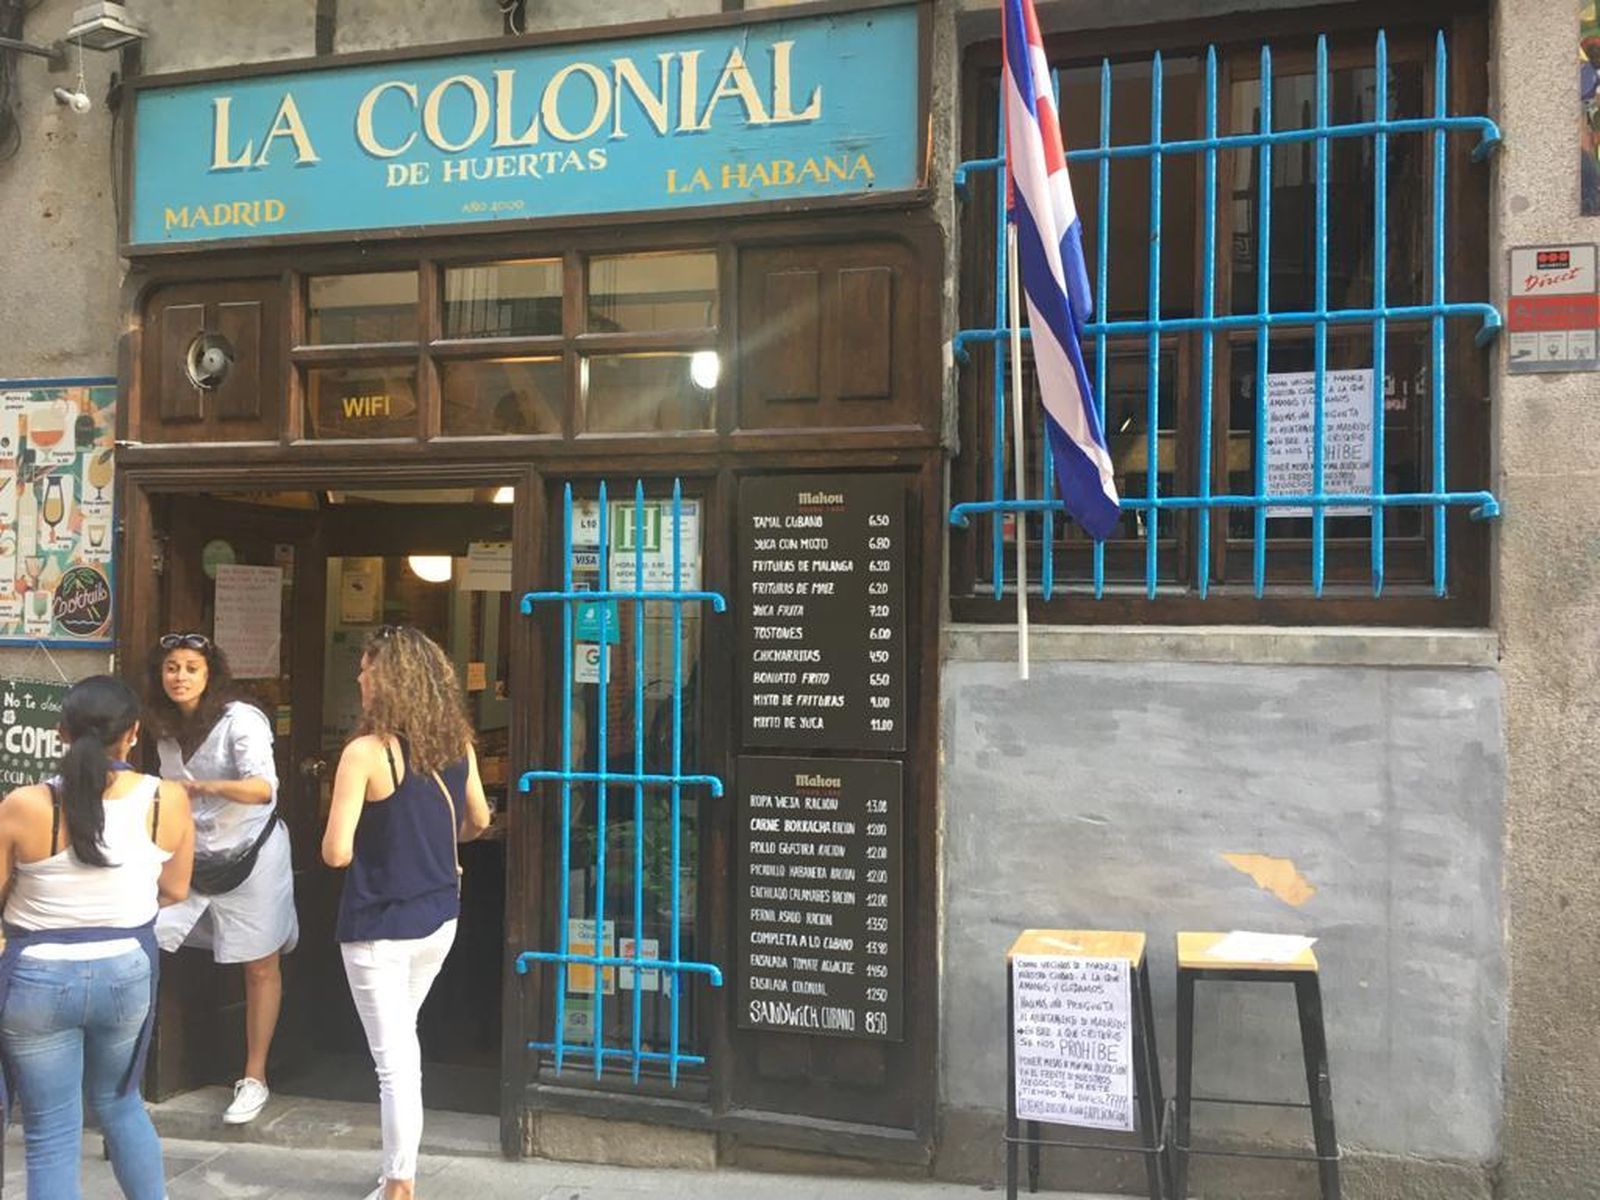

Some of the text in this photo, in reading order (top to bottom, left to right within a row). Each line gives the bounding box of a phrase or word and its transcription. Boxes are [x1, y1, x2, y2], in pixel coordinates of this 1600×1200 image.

[209, 40, 822, 170] LA COLONIAL
[386, 148, 608, 187] DE HUERTAS
[665, 154, 876, 193] LA HABANA
[164, 199, 286, 229] MADRID
[1524, 267, 1584, 292] Direct
[341, 395, 391, 418] WIFI
[798, 491, 843, 504] Mahou
[619, 507, 658, 549] H
[785, 515, 823, 528] CUBANO
[575, 555, 597, 564] VISA
[798, 561, 809, 572] DE
[796, 582, 809, 594] DE
[753, 626, 803, 639] TOSTONES
[4, 691, 20, 708] No
[781, 694, 793, 706] DE
[796, 694, 845, 707] FRITURAS
[784, 717, 796, 728] DE
[795, 774, 841, 787] Mahou
[750, 931, 798, 947] COMPLETA
[799, 935, 808, 947] A
[808, 935, 821, 948] LO
[1059, 1038, 1120, 1063] PROHIBE
